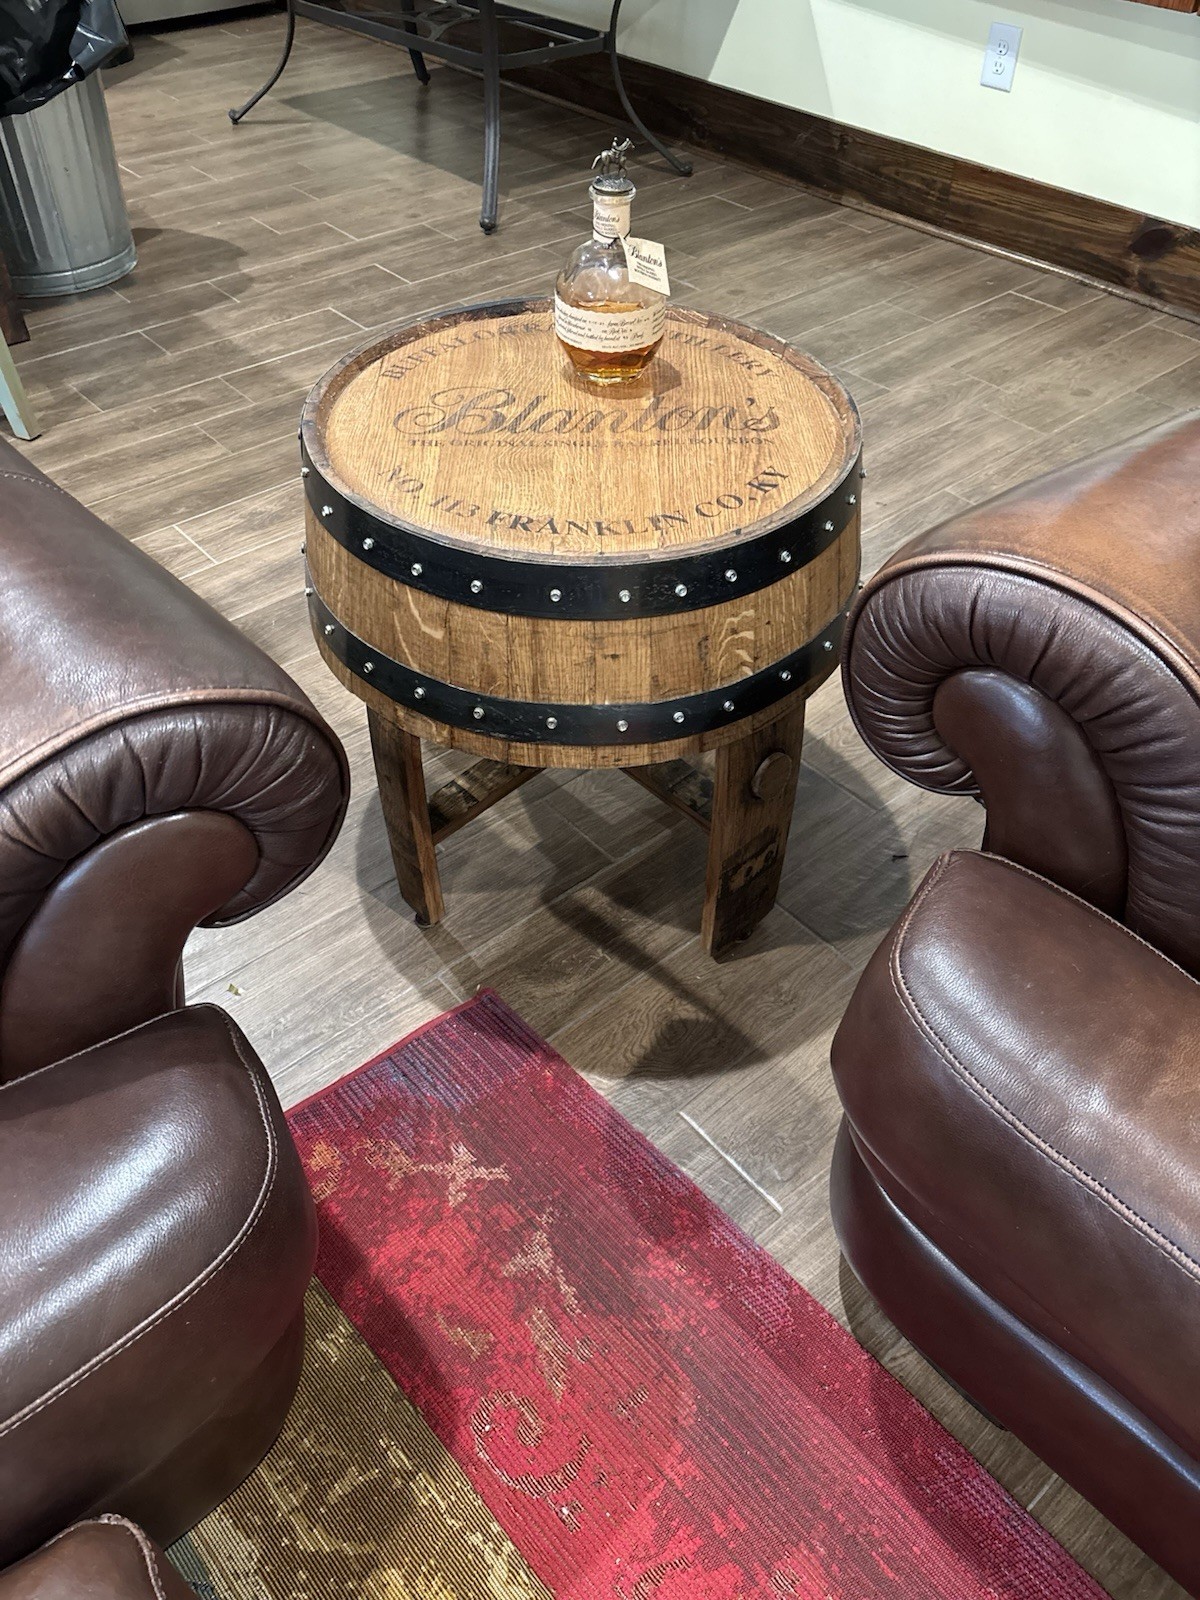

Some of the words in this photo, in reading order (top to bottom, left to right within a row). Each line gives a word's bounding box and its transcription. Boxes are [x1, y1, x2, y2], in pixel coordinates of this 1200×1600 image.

[380, 330, 495, 381] BUFFALO
[393, 386, 781, 435] Blanton's
[429, 495, 480, 518] 113
[485, 510, 690, 537] FRANKLIN
